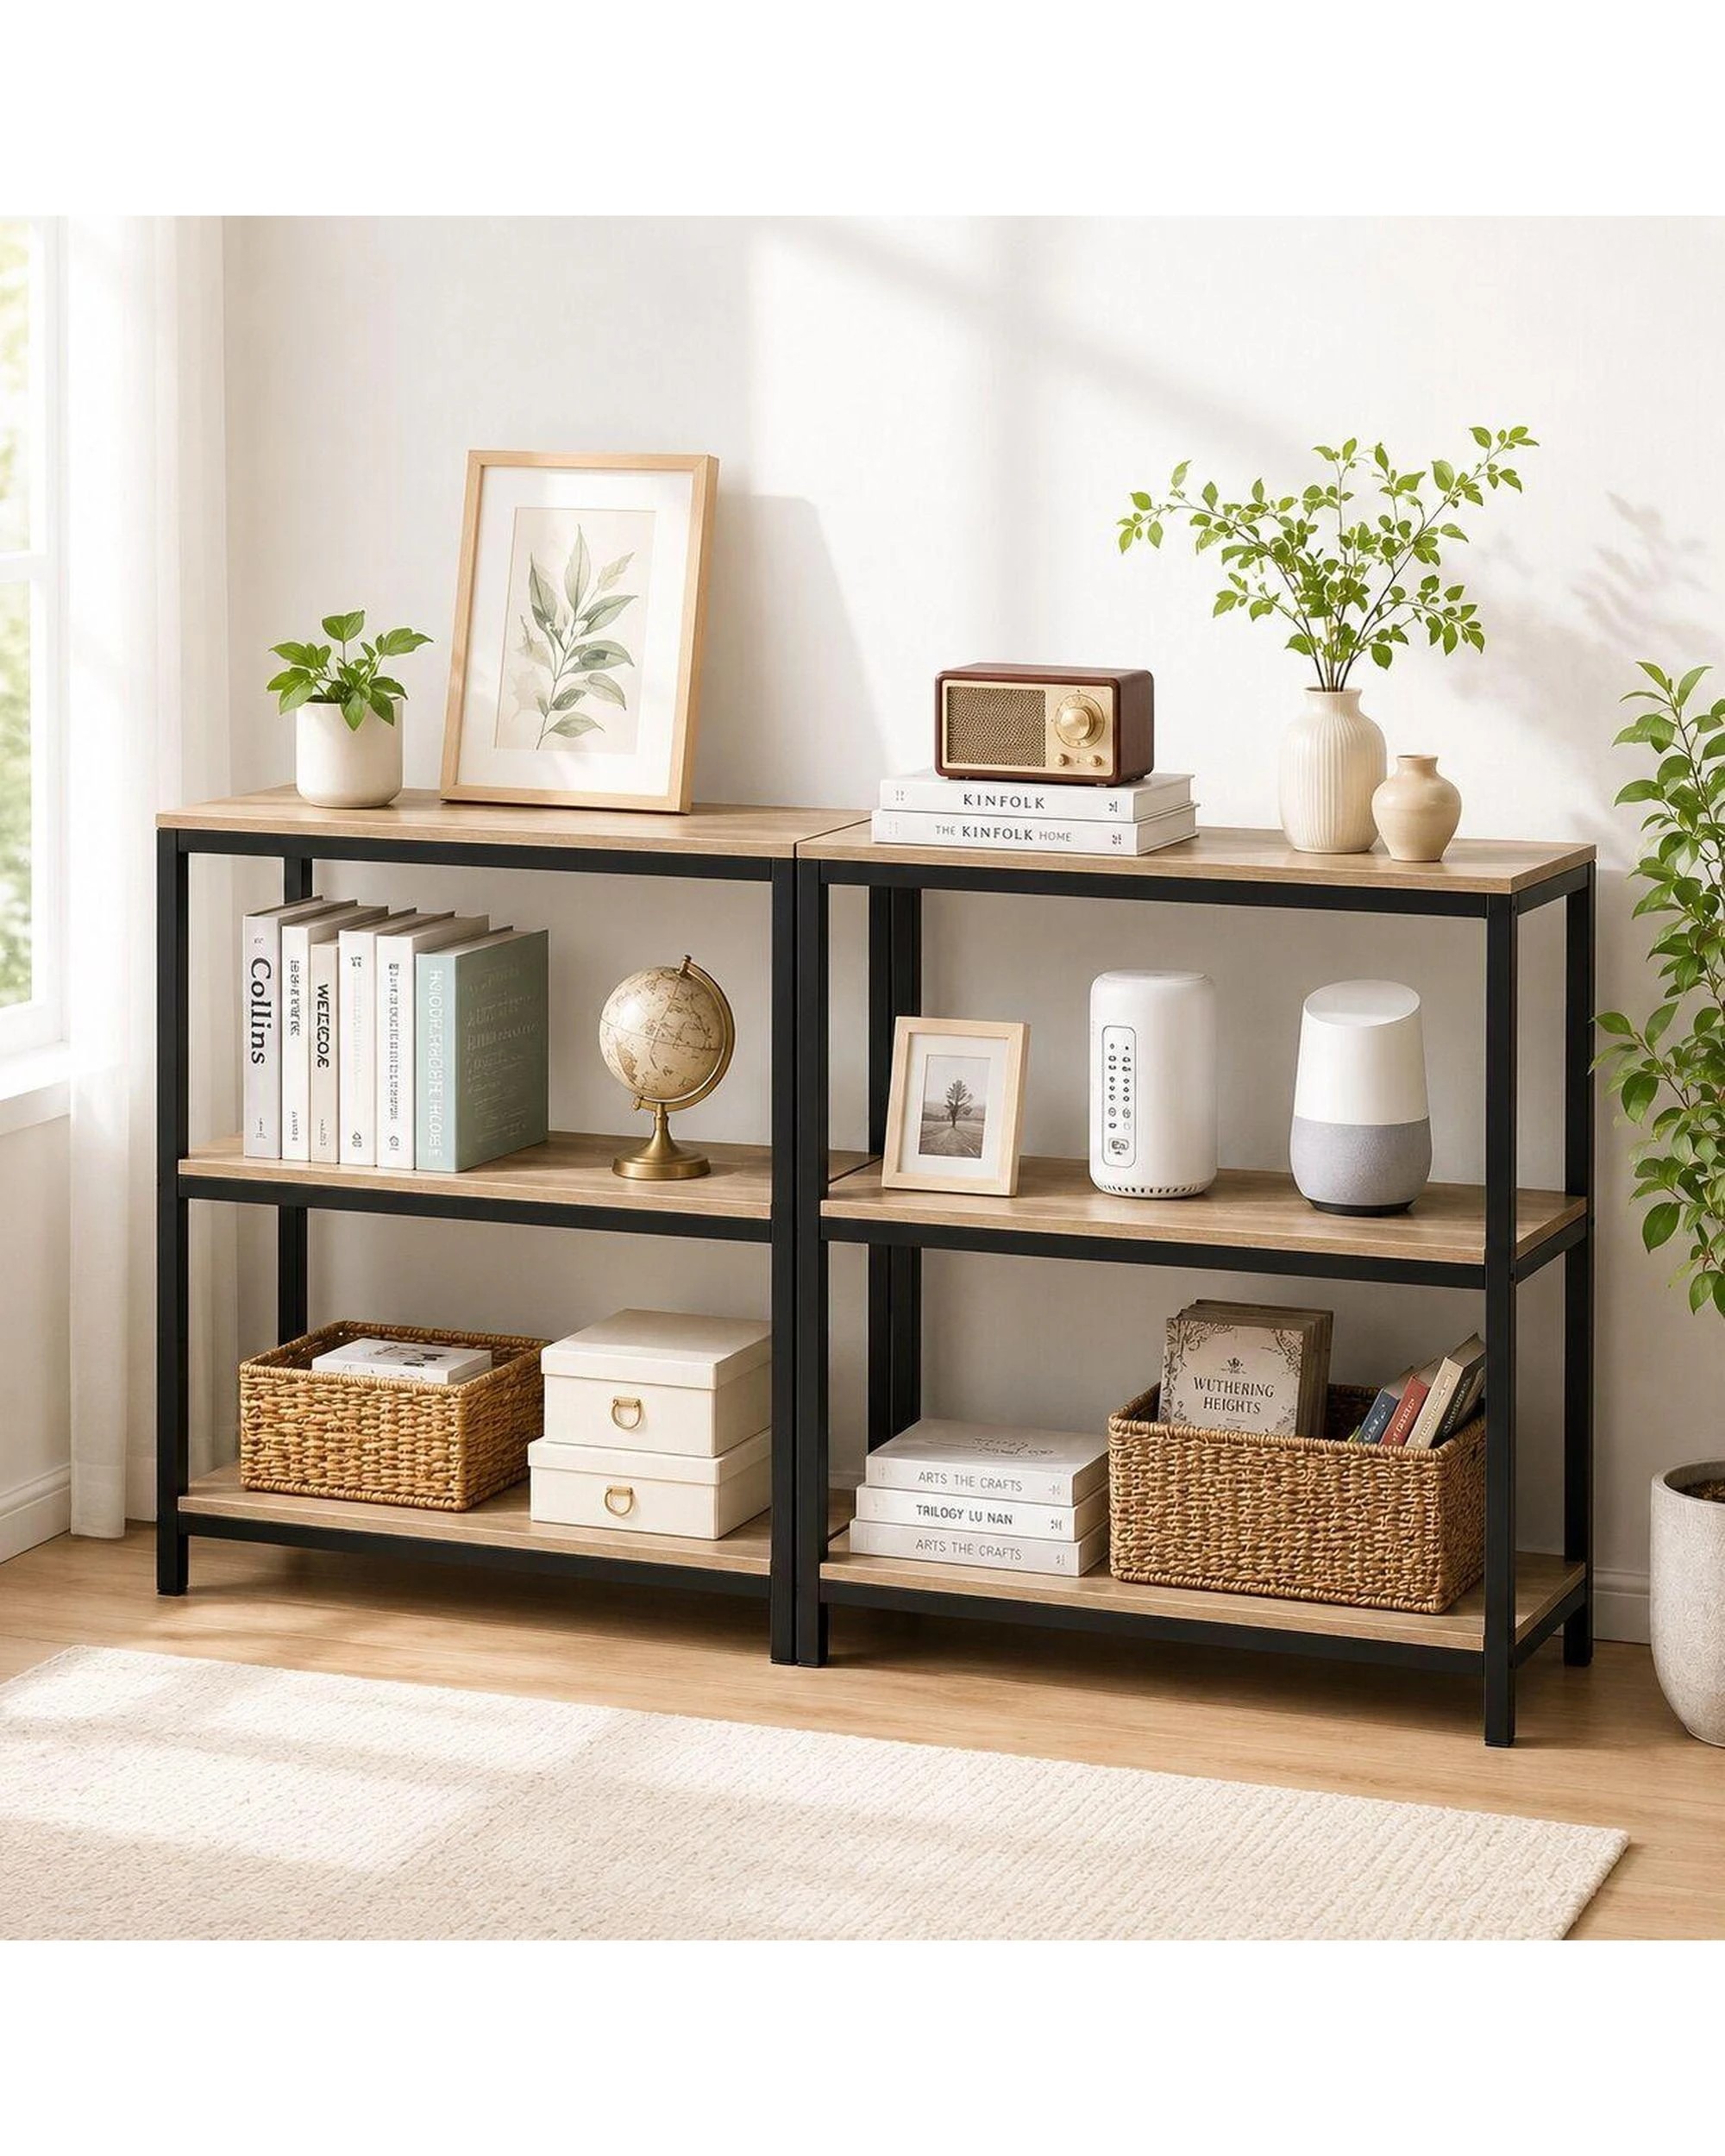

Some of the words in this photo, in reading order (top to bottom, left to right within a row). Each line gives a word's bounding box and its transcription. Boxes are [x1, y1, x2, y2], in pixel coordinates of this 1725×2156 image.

[963, 793, 1045, 810] KINFOLK
[936, 824, 957, 837] THE
[962, 825, 1033, 842] KINFOLK
[1038, 830, 1072, 843] HOME
[250, 956, 272, 1065] Collins
[1193, 1376, 1276, 1399] WUTHERING
[1203, 1396, 1261, 1414] HEIGHTS
[918, 1471, 948, 1485] ARTS
[954, 1474, 975, 1488] THE
[980, 1476, 1023, 1492] CRAFTS
[916, 1504, 964, 1520] TRILOGY
[969, 1509, 983, 1523] LU
[987, 1512, 1013, 1526] NAN
[915, 1539, 946, 1553] ARTS
[951, 1541, 974, 1556] THE
[978, 1544, 1022, 1561] CRAFTS
